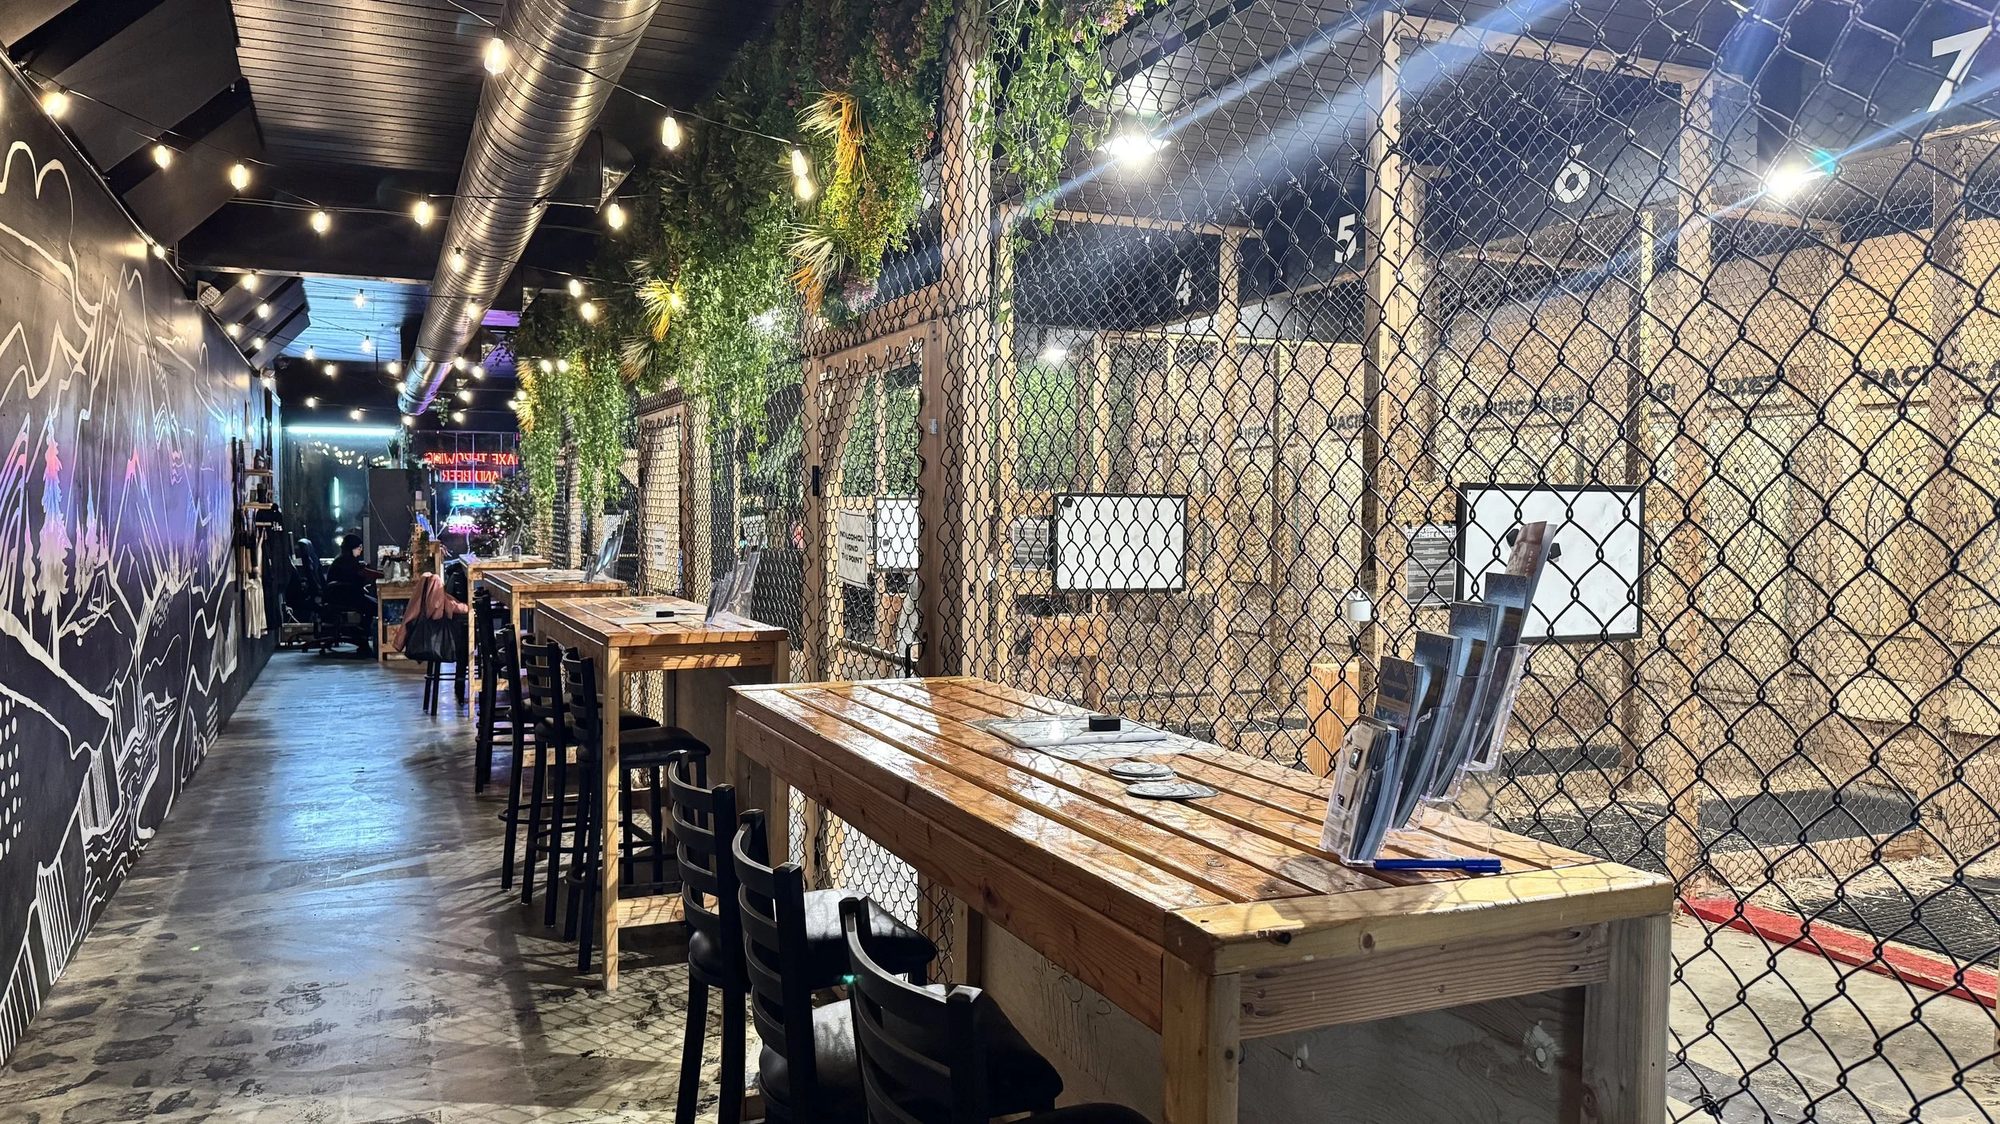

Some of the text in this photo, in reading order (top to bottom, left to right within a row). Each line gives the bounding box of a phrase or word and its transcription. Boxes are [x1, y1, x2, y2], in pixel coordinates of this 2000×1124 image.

[1926, 25, 1992, 113] 7
[1554, 143, 1590, 203] 6
[1334, 213, 1357, 263] 5
[1175, 268, 1191, 305] 4
